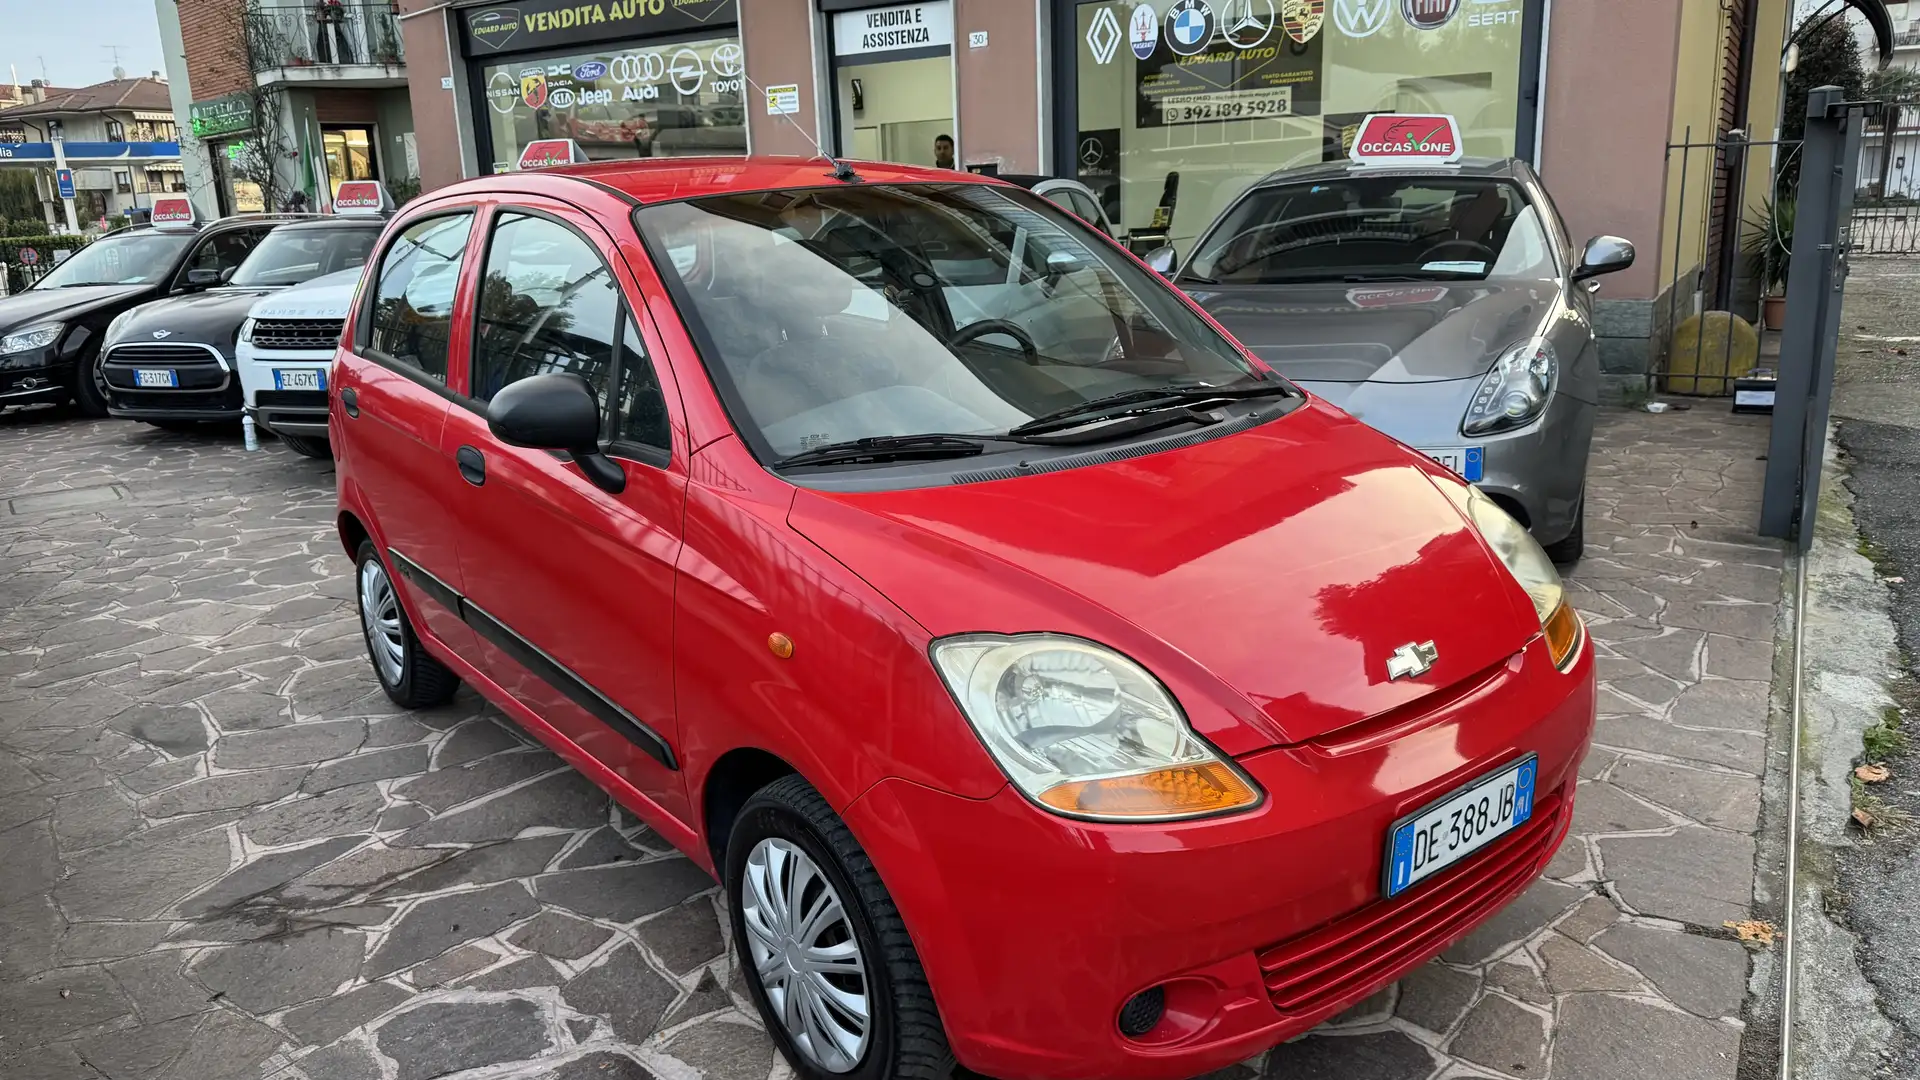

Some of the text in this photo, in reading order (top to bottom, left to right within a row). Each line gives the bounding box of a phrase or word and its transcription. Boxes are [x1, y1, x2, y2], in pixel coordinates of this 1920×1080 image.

[524, 0, 665, 33] VENDITA AUTO
[866, 8, 922, 29] VENDITA E
[1169, 0, 1212, 20] BMW
[1468, 10, 1520, 27] SEAT
[474, 22, 517, 35] EDUARD AUTO
[863, 27, 929, 49] ASSISTENZA
[972, 34, 984, 45] 30
[1179, 47, 1275, 67] EDUARD AUTO
[580, 64, 601, 79] Ford
[486, 87, 520, 98] NISSAN
[548, 80, 573, 88] DACIA
[622, 83, 659, 101] Audi
[553, 92, 572, 104] KIA
[577, 87, 613, 106] Jeep
[1184, 99, 1287, 119] 392 189 5928
